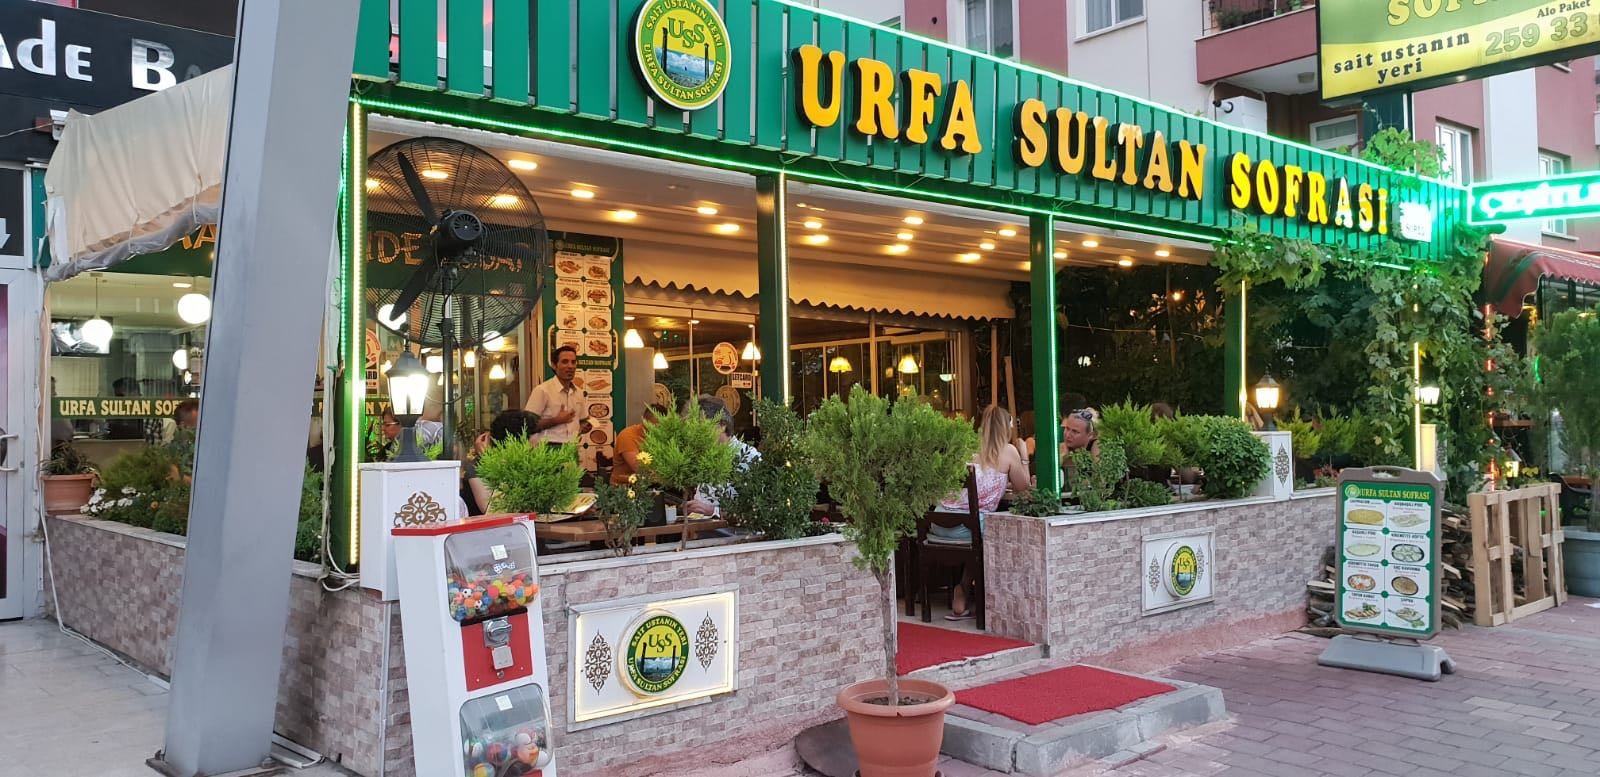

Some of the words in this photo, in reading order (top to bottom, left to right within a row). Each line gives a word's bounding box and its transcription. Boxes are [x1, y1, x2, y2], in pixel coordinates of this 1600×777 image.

[1537, 9, 1556, 19] Alo
[1559, 0, 1591, 13] Paket
[667, 17, 705, 49] USS
[1485, 22, 1541, 56] 259
[1550, 11, 1588, 41] 33
[643, 43, 658, 77] URFA
[657, 75, 694, 100] SULTAN
[1333, 53, 1374, 74] sait
[1377, 58, 1423, 84] yeri
[799, 44, 983, 155] URFA
[1018, 98, 1207, 201] SULTAN
[1229, 151, 1388, 235] SOFRASI
[59, 400, 97, 416] URFA
[100, 400, 151, 416] SULTAN
[1378, 489, 1401, 498] SULTAN
[1401, 490, 1430, 500] SOFRASI
[648, 633, 673, 653] USS
[636, 679, 663, 692] SULTAN
